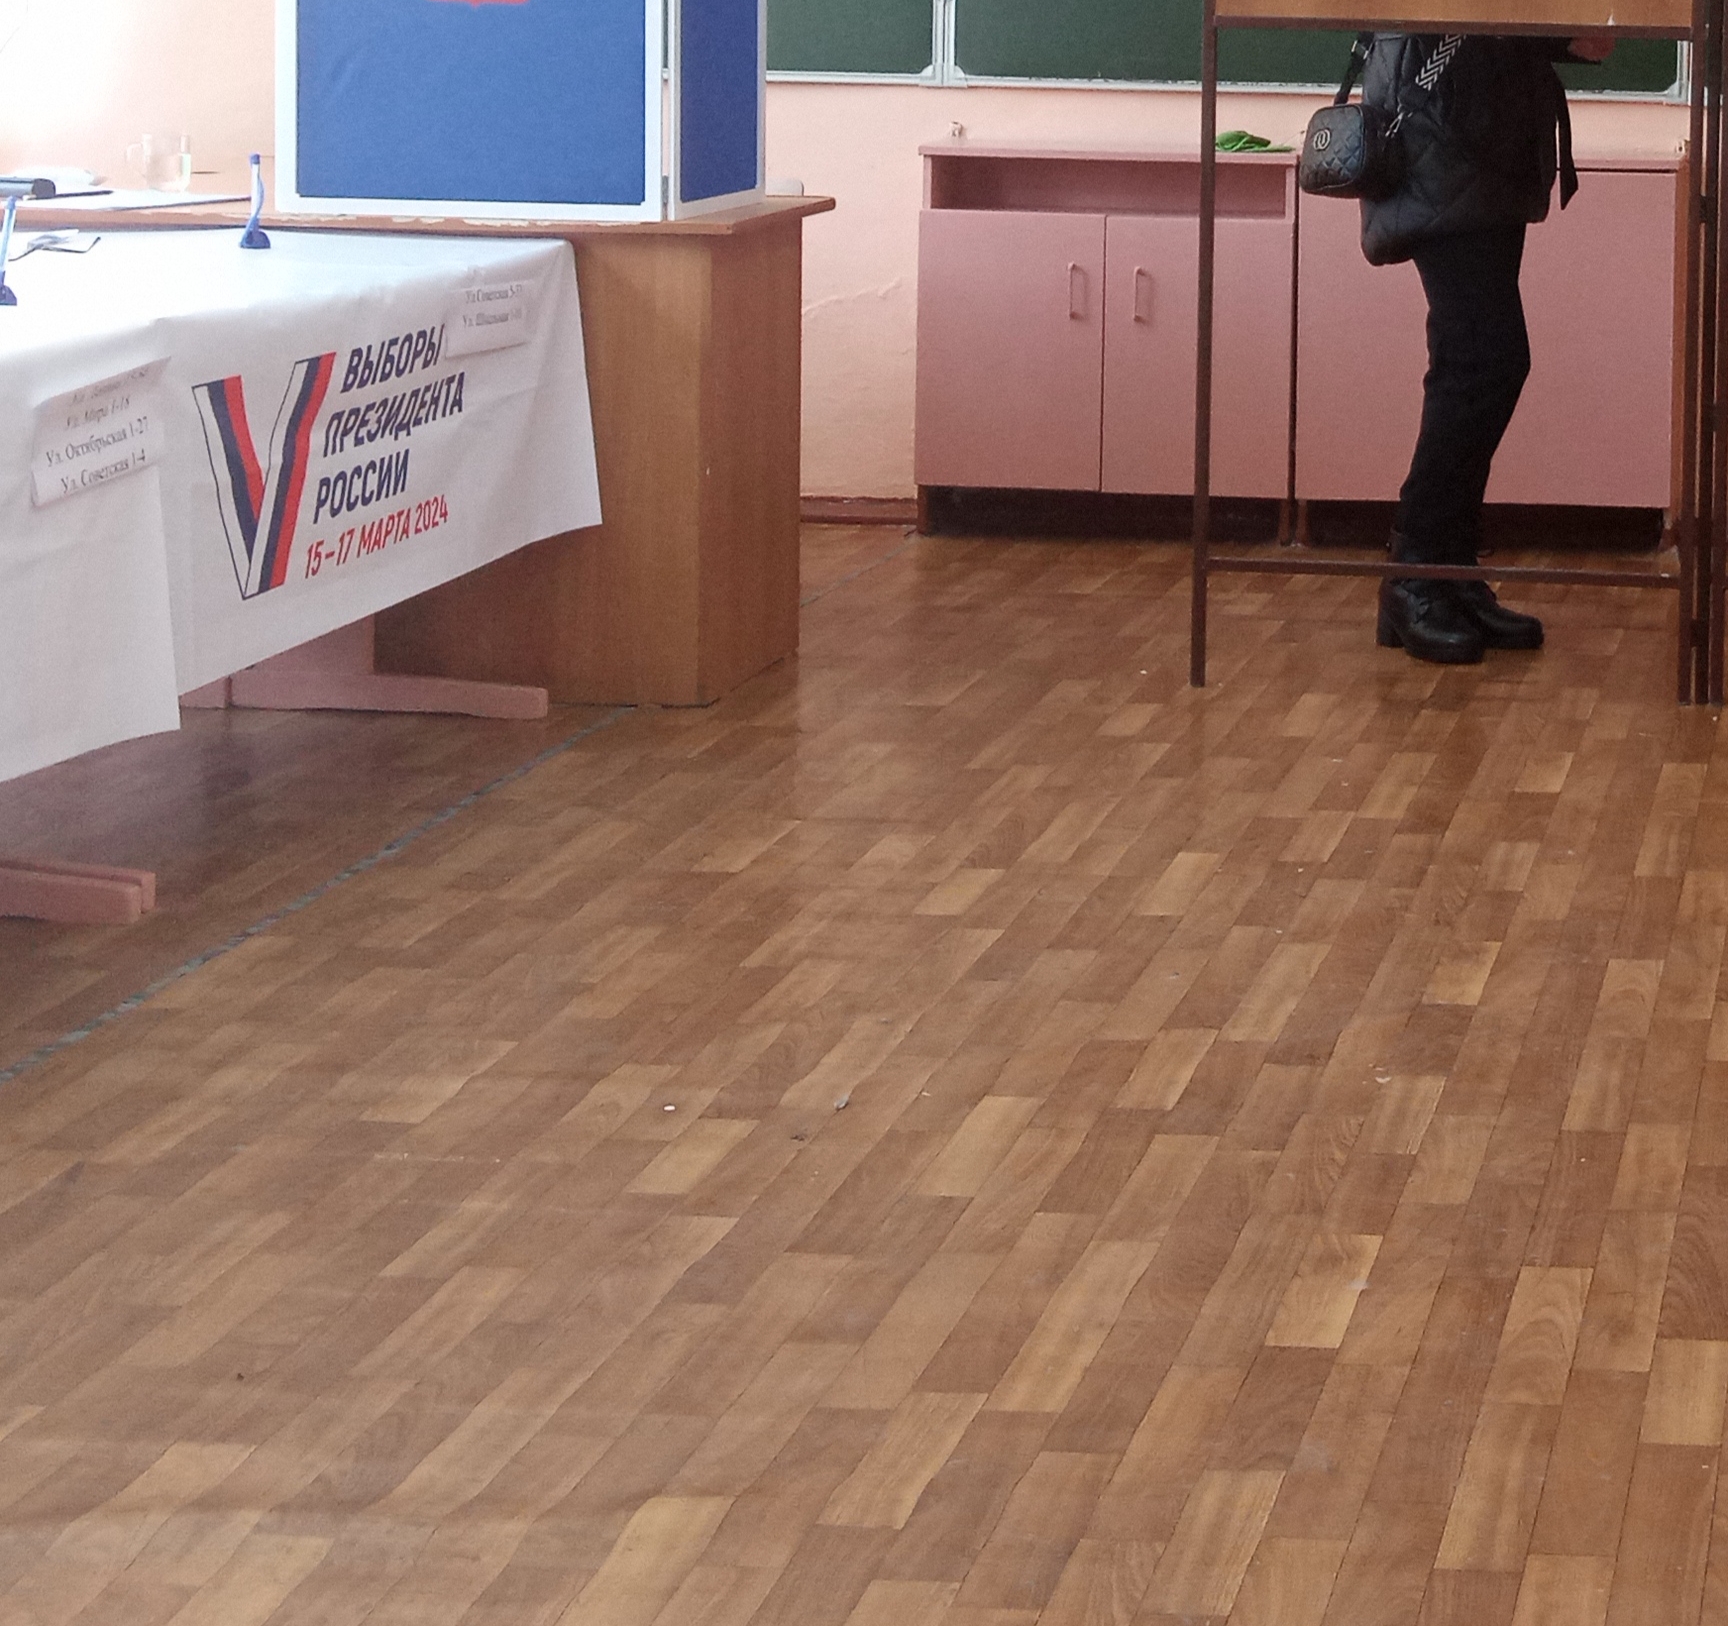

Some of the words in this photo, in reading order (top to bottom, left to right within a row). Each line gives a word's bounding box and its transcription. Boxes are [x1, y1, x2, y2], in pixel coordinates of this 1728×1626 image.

[340, 324, 445, 394] ВЫБОРЫ
[323, 371, 465, 458] ПРЕЗИДЕНТА
[313, 448, 410, 524] РОССИИ
[357, 507, 412, 558] МАРТА
[414, 494, 448, 535] 2024
